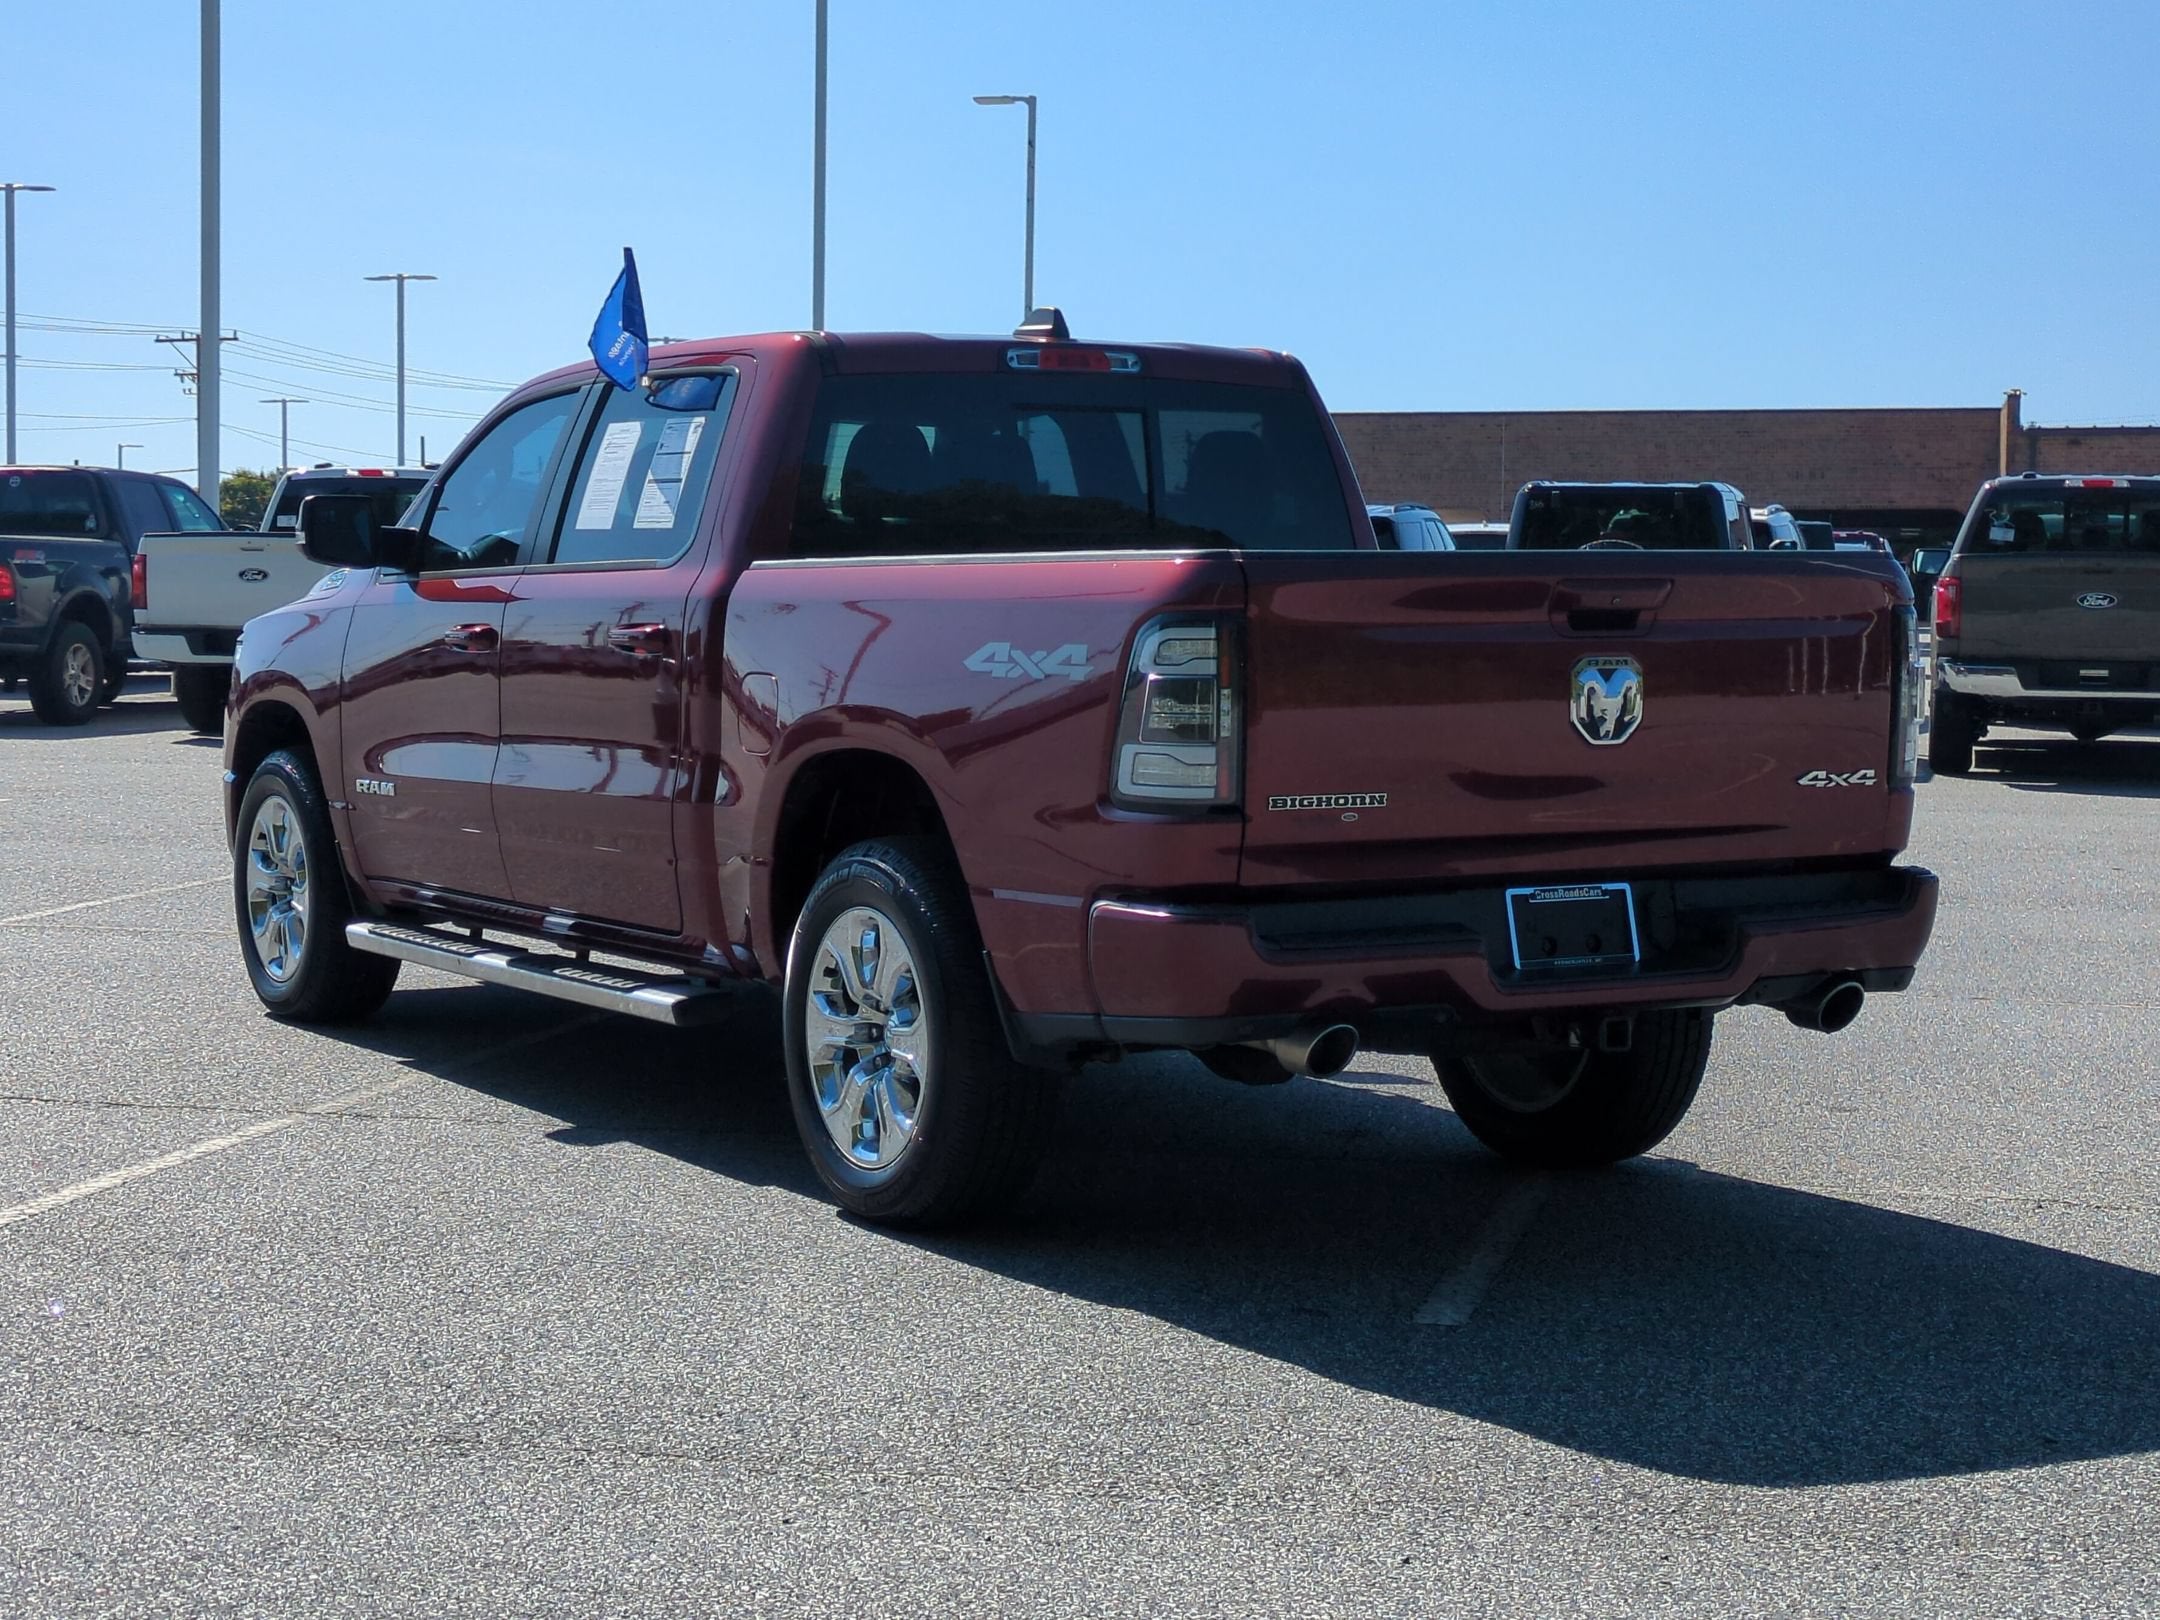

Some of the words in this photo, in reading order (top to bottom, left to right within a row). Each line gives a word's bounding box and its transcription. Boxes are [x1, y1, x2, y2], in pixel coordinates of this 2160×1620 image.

[1588, 659, 1629, 667] RAM
[355, 779, 395, 797] RAM
[1535, 886, 1602, 900] CrossRoadsCars
